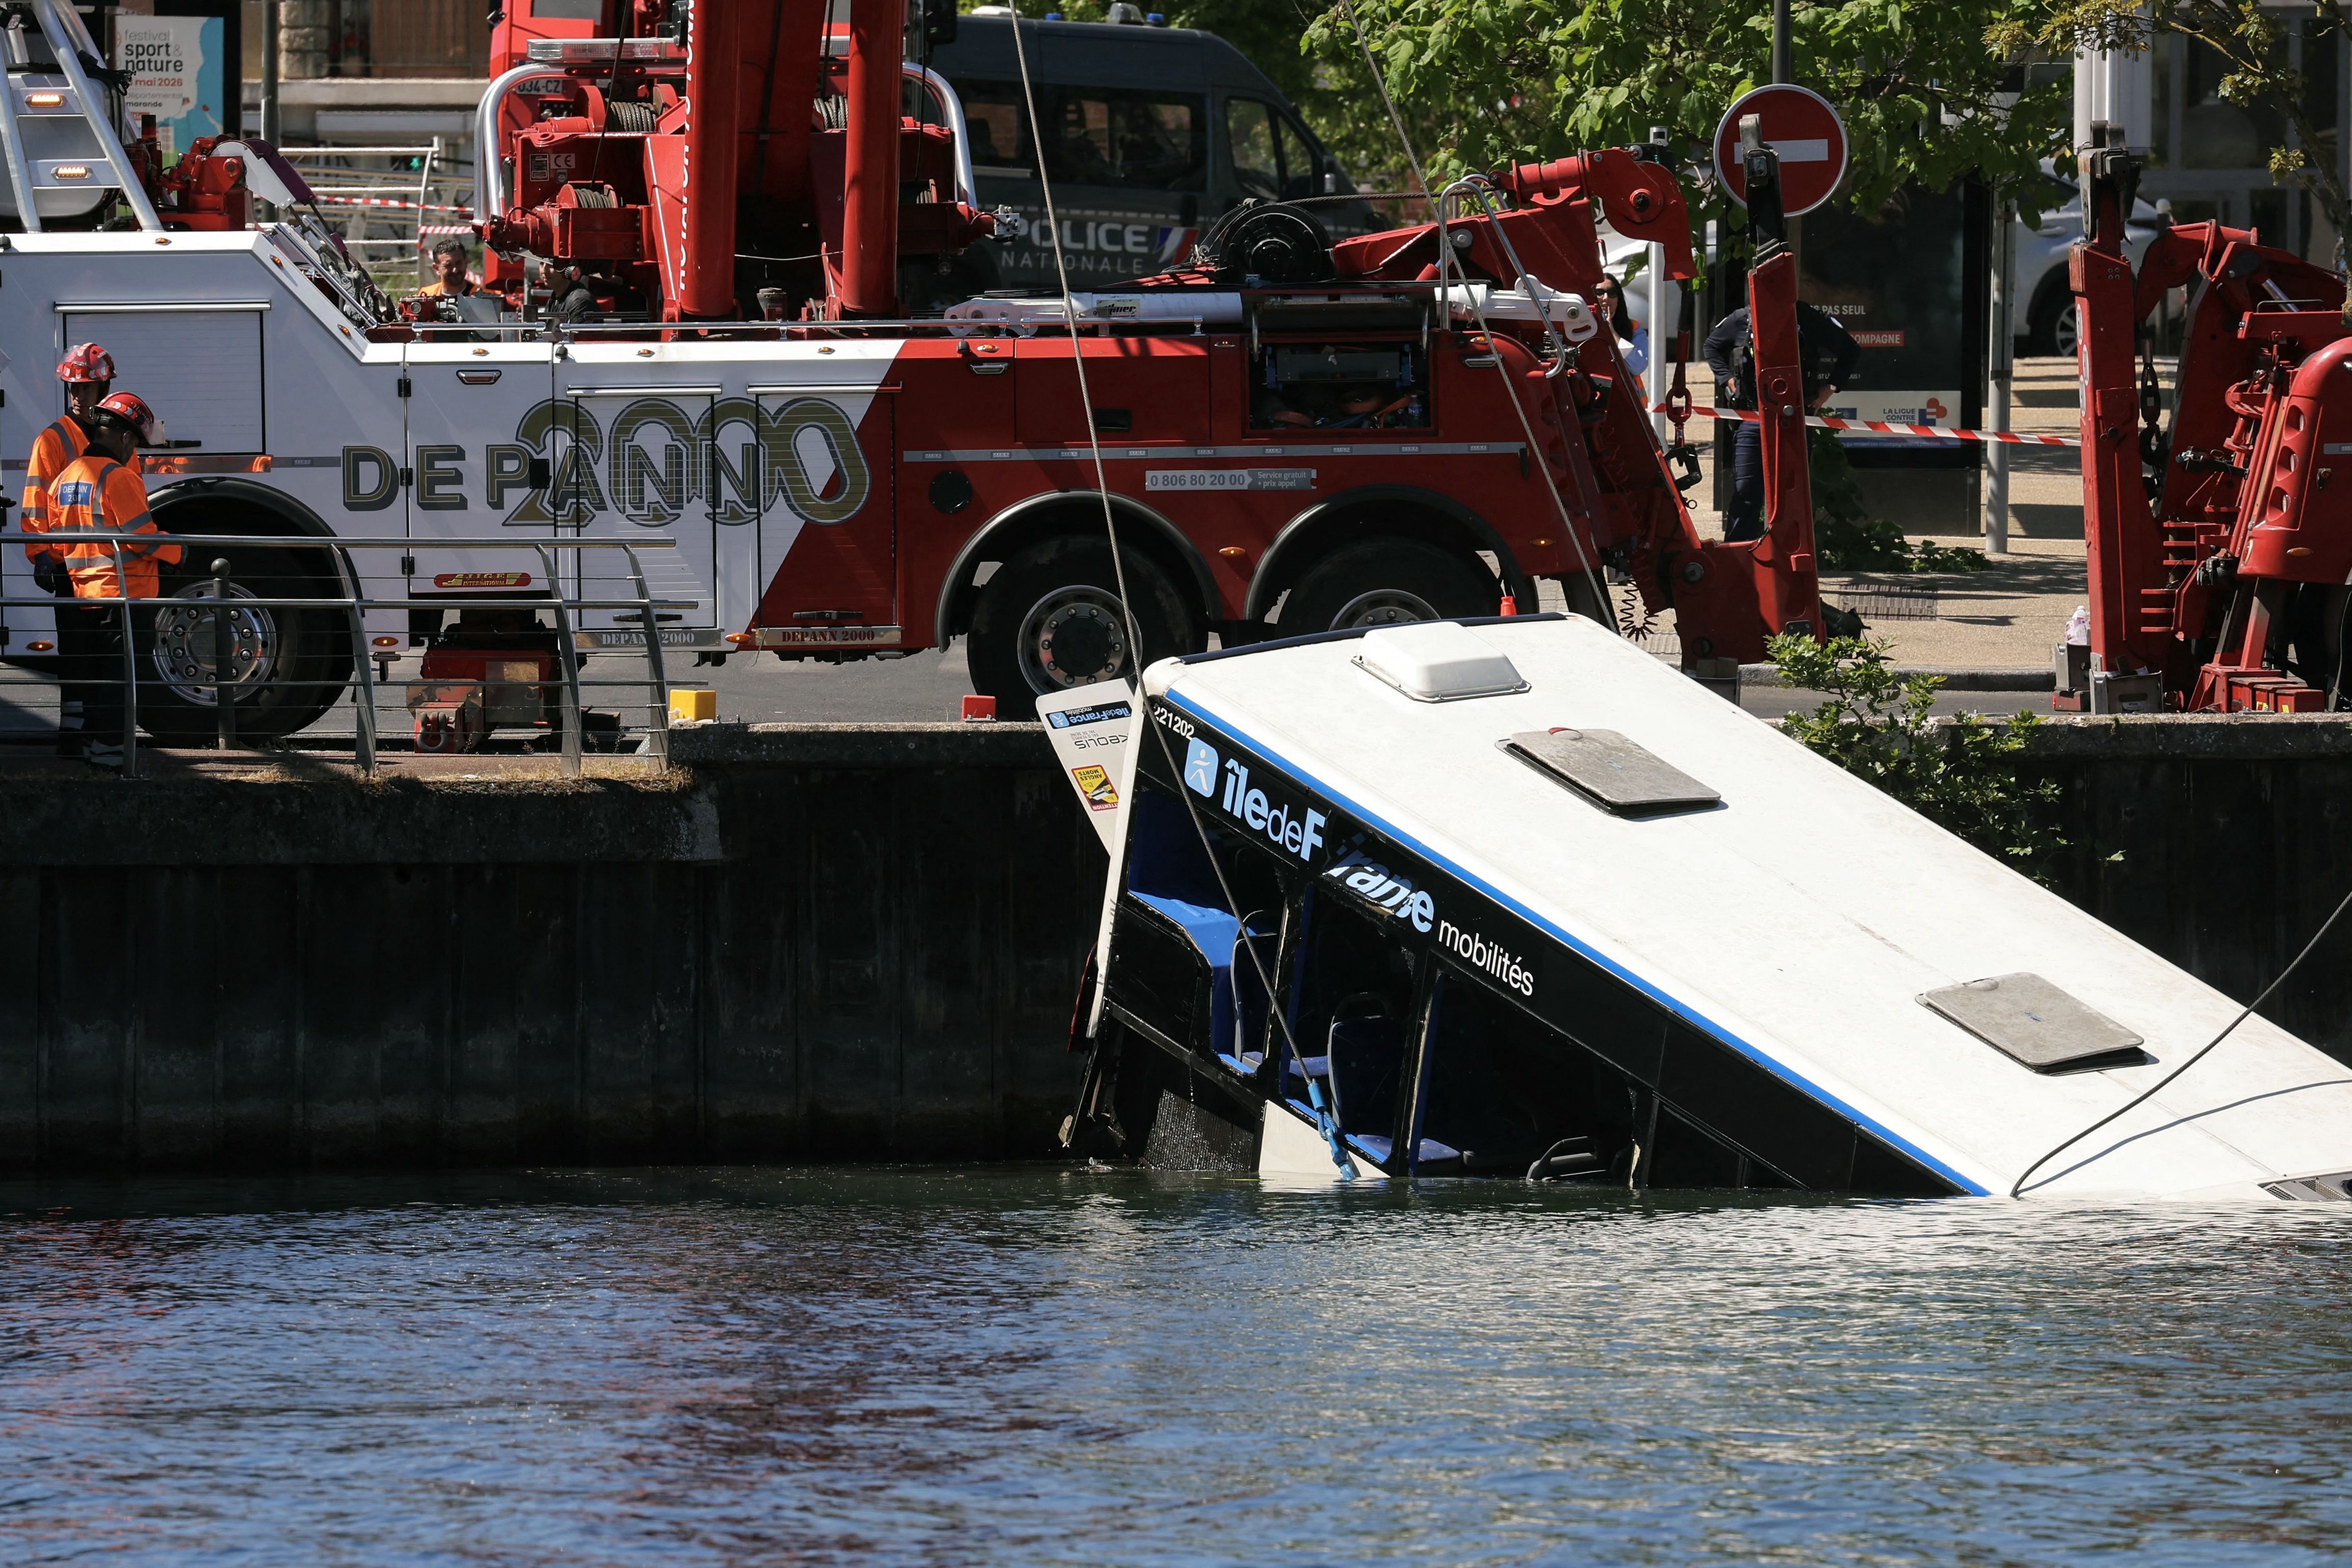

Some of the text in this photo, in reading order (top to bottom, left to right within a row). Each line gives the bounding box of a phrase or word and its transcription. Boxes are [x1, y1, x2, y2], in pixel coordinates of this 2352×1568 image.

[125, 29, 170, 41] festival
[125, 43, 182, 59] sport &
[126, 58, 183, 72] nature
[136, 76, 155, 86] mai
[158, 78, 183, 86] 2026
[1004, 218, 1148, 253] POLICE
[1002, 251, 1144, 274] NATIONALE
[1822, 305, 1840, 315] PAS
[1842, 305, 1866, 315] SEUL
[342, 443, 759, 511] DEPANN
[1150, 474, 1246, 486] 0 806 80 20 00
[1284, 471, 1306, 480] gratuit
[63, 485, 87, 493] DEPNN
[1263, 480, 1276, 489] prix
[1278, 480, 1296, 489] appel
[602, 632, 694, 644] DEPAN 2000
[782, 630, 875, 642] DEPANN 2000
[1065, 707, 1092, 715] mobilités
[1439, 919, 1533, 995] mobilités
